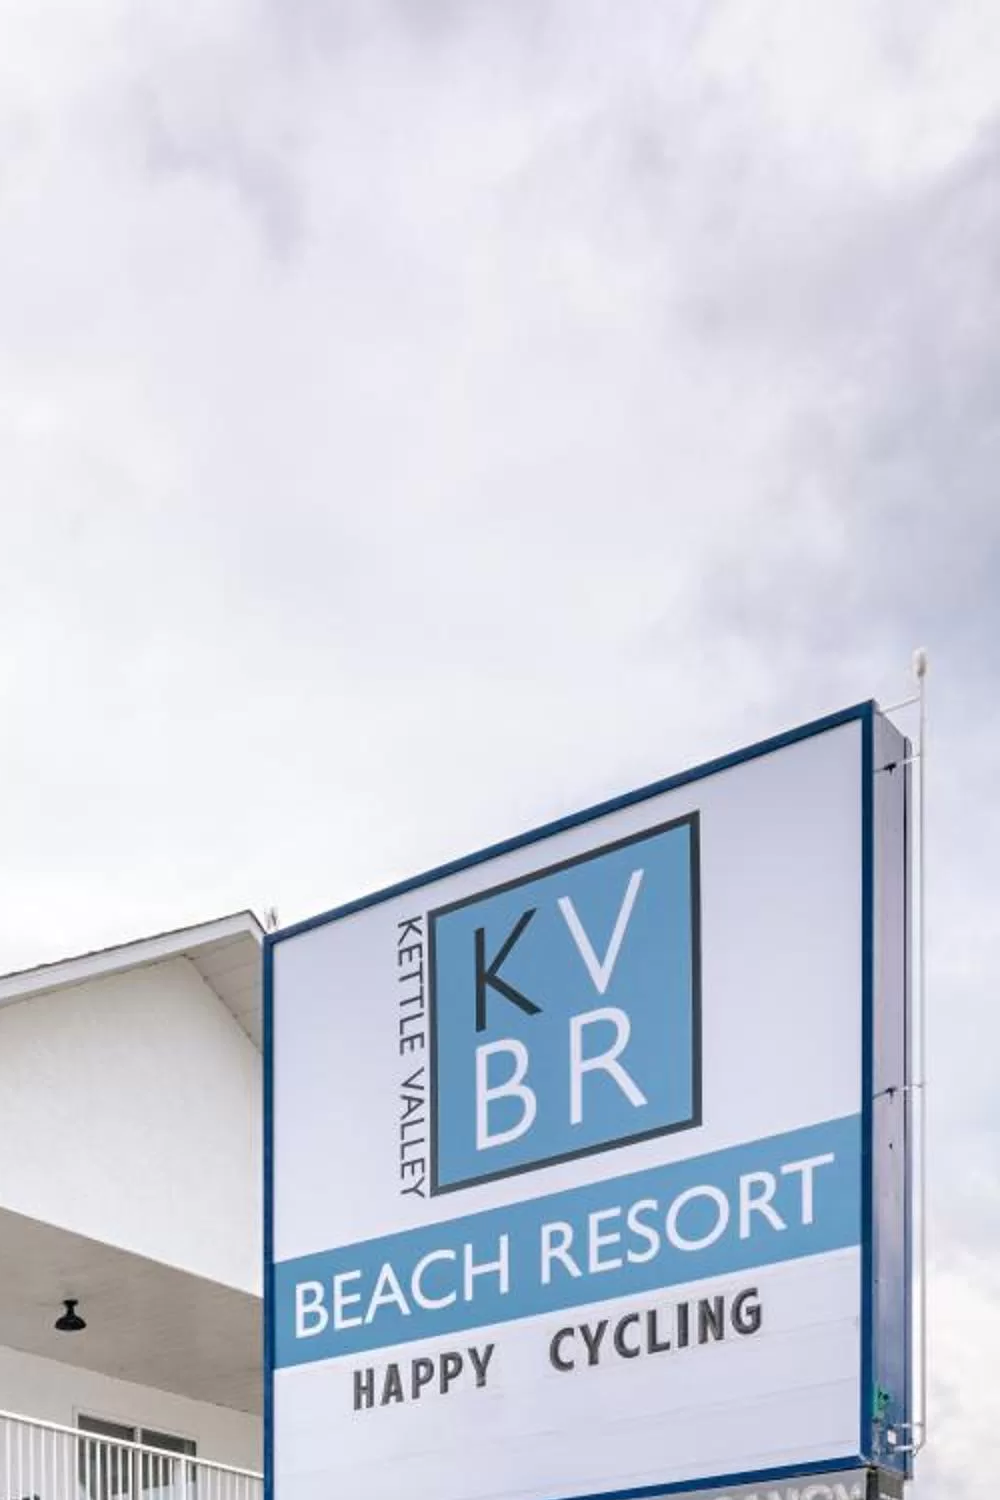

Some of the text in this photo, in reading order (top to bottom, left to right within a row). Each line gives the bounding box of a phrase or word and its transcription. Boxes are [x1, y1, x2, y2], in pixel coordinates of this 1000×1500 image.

[397, 915, 426, 1198] KETTLE VALLEY
[295, 1153, 835, 1338] BEACH RESORT
[353, 1287, 762, 1411] HAPPY CYCLING
